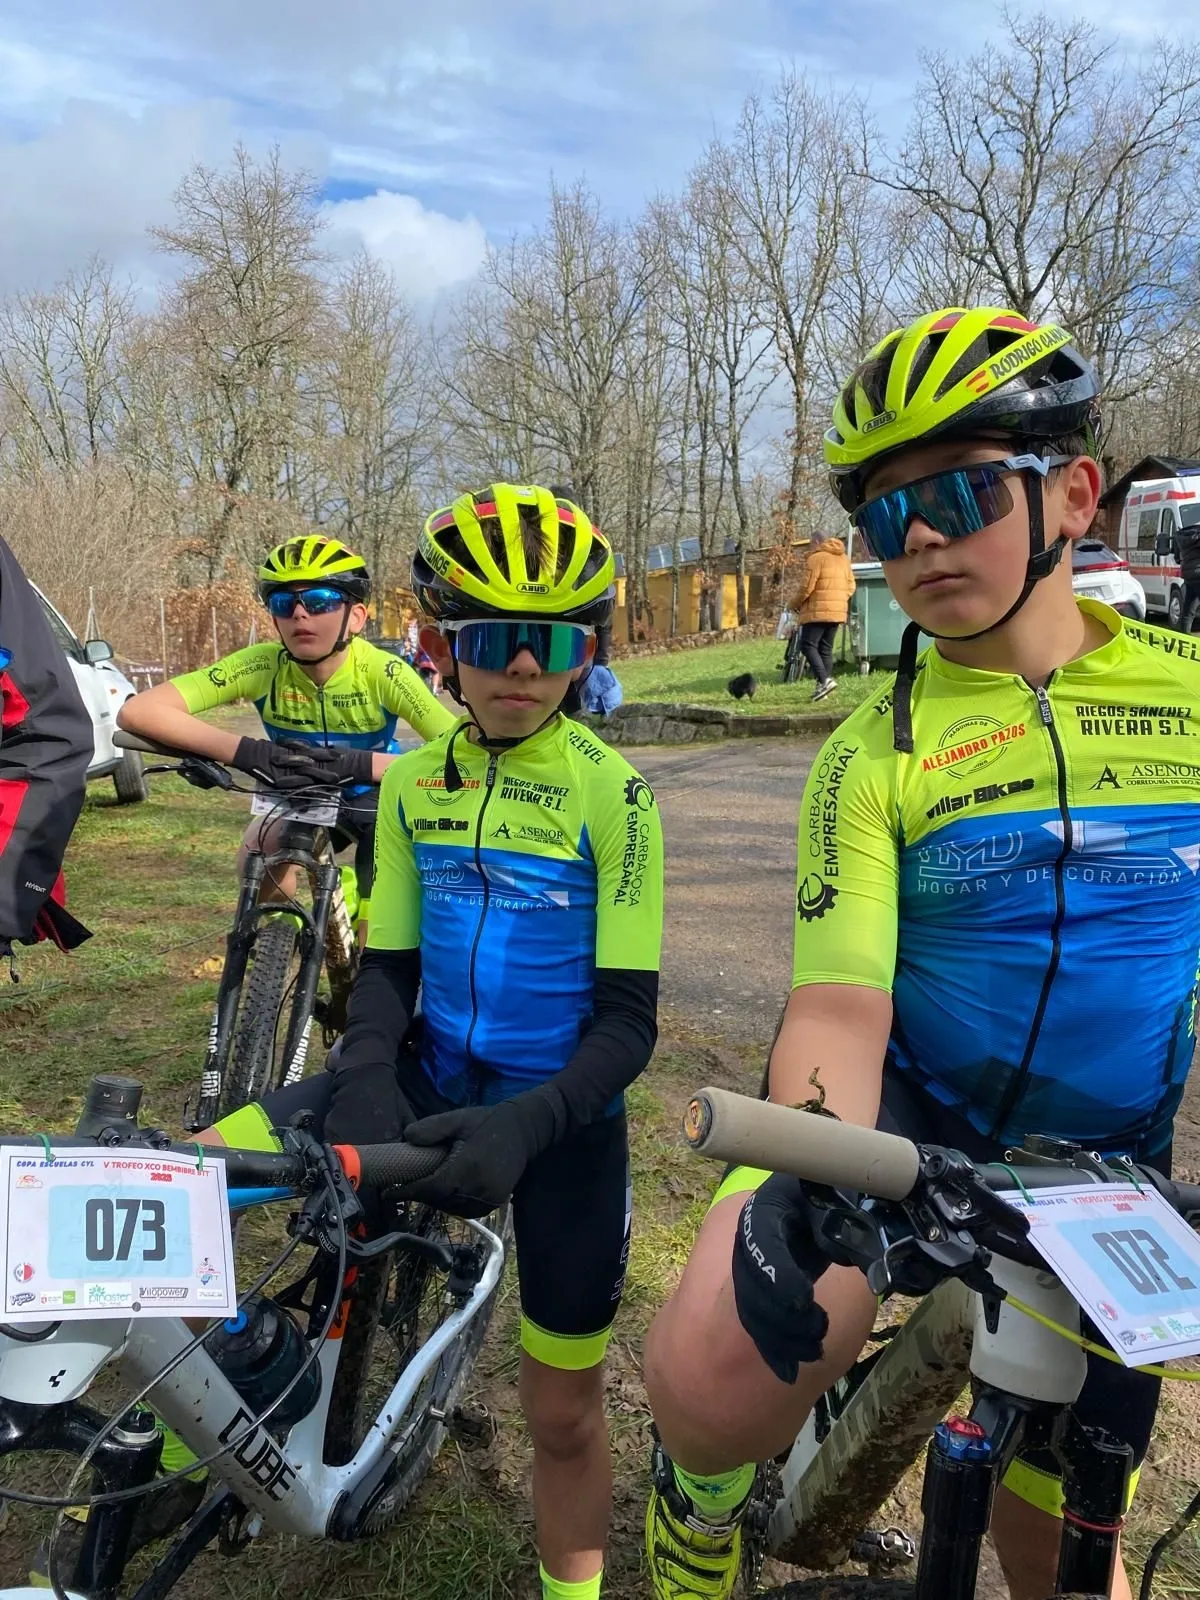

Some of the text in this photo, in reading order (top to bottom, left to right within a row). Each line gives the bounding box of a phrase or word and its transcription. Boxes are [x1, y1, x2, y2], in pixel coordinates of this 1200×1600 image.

[989, 338, 1043, 380] RODRIGO
[866, 412, 893, 432] ABUS
[520, 584, 547, 593] ABUS
[1075, 704, 1193, 719] RIEGOS SÁNCHEZ
[1080, 718, 1197, 737] RIVERA S.L.
[922, 723, 1026, 772] ALEJANDRO PAZOS
[503, 776, 532, 789] RIEGOS
[1131, 764, 1200, 778] ASENOR
[500, 787, 567, 812] RIVERA S.L.
[809, 740, 845, 858] CARBAJOSA
[823, 746, 859, 877] EMPRESARIAL
[520, 825, 564, 840] ASENOR
[614, 811, 638, 906] EMPRESARIAL
[628, 823, 650, 907] CARBAJOSA
[918, 879, 987, 895] HOGAR
[1000, 873, 1012, 888] Y
[39, 1160, 78, 1168] ESCUELAS
[112, 1161, 143, 1169] TROFEO
[144, 1162, 161, 1171] XCO
[85, 1198, 167, 1262] 073
[743, 1193, 776, 1284] ENDURA
[1092, 1229, 1198, 1296] 072
[217, 1406, 296, 1502] CUBE
